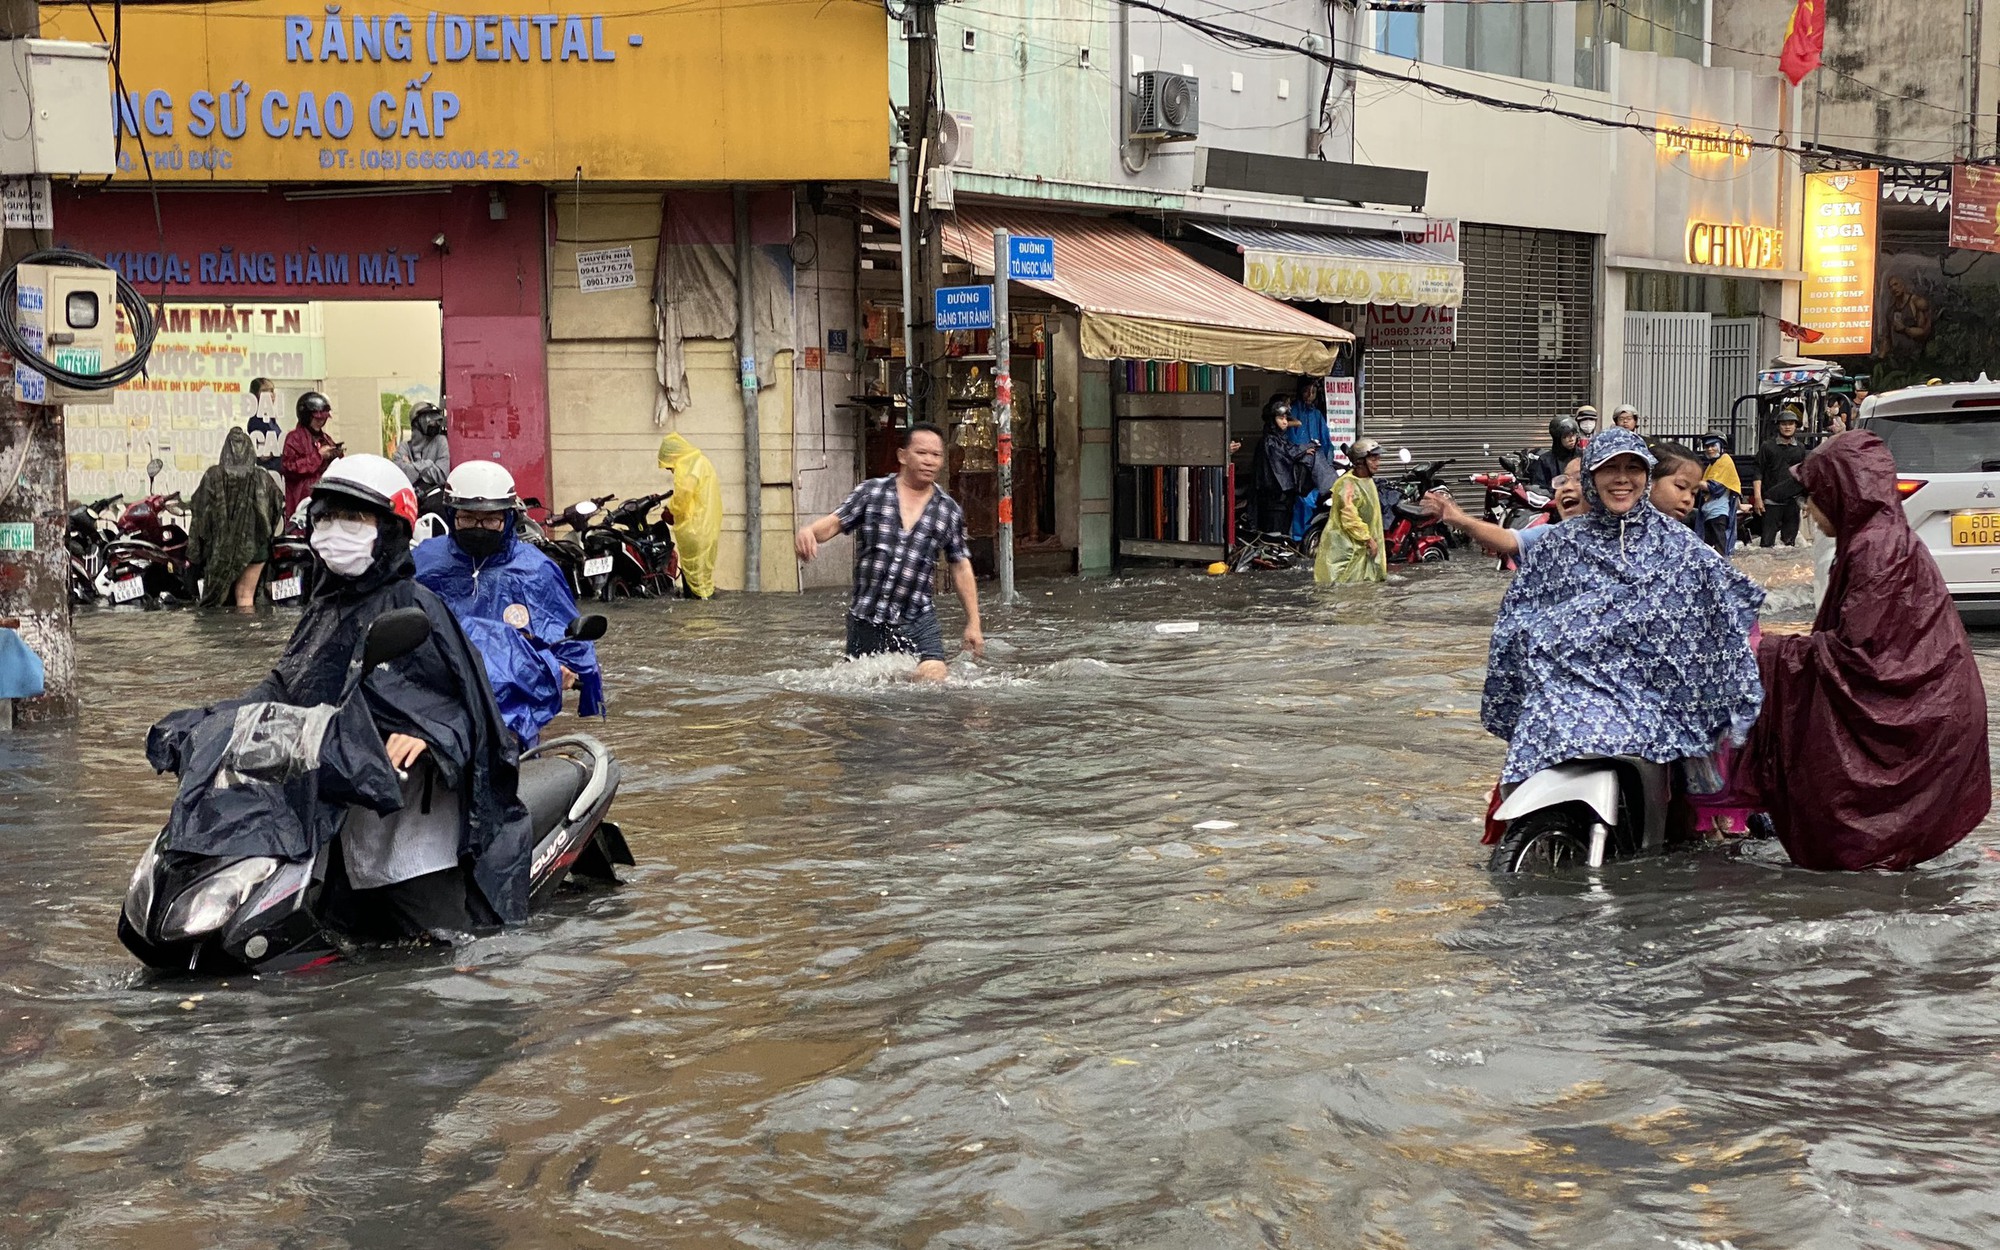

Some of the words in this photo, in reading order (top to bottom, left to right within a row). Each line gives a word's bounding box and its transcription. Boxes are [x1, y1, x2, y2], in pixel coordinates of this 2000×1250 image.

[285, 4, 412, 61] RĂNG
[188, 80, 250, 138] SỨ
[262, 90, 354, 138] CAO
[369, 71, 460, 138] CẤP
[1820, 202, 1861, 216] GYM
[1816, 224, 1864, 238] YOGA
[1019, 241, 1045, 254] ĐƯỜNG
[106, 252, 191, 283] KHOA:
[200, 245, 277, 284] RĂNG
[285, 245, 349, 284] HÀM
[358, 247, 419, 290] MẶT
[1012, 258, 1020, 274] TÔ
[1021, 261, 1039, 277] NGỌC
[1376, 271, 1414, 299] XE
[947, 292, 980, 305] ĐƯỜNG
[1810, 291, 1834, 299] BODY
[1836, 290, 1864, 298] PUMP
[1830, 305, 1870, 313] COMBAT
[261, 309, 301, 334] T.N
[938, 310, 957, 328] ĐẶNG
[957, 311, 969, 327] THỊ
[1833, 336, 1864, 344] DANCE
